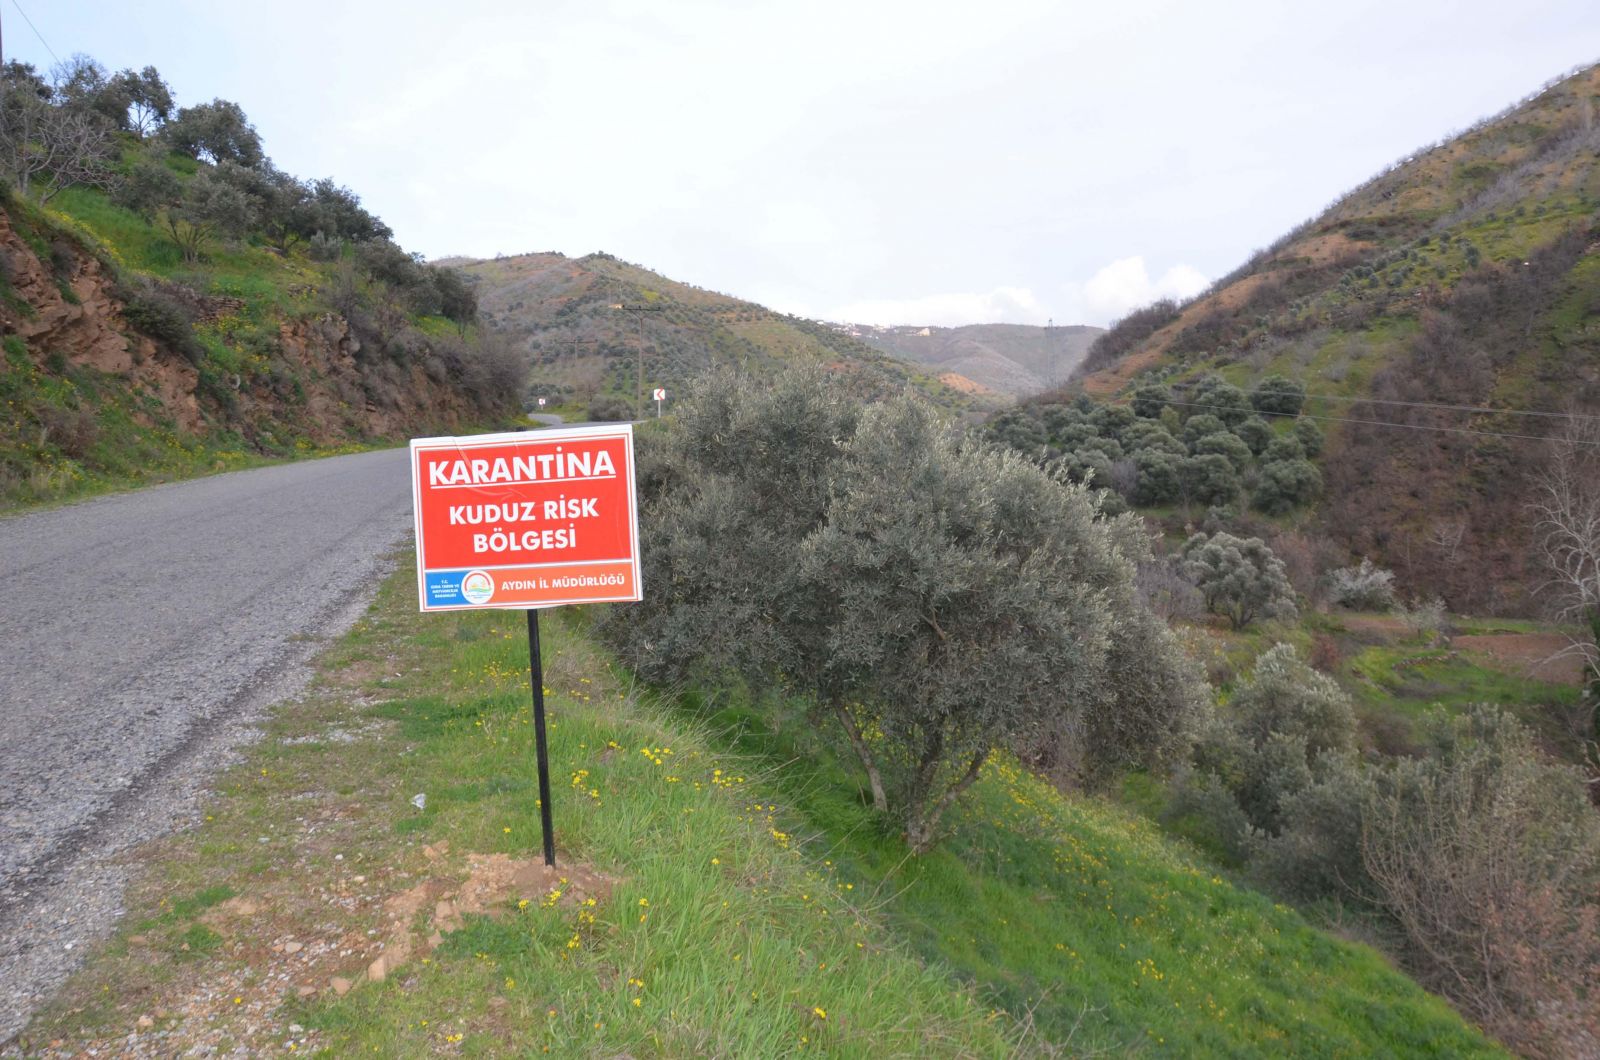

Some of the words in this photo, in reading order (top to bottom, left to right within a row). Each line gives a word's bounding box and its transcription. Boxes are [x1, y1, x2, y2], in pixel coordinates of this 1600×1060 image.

[428, 446, 616, 486] KARANTİNA
[449, 502, 536, 525] KUDUZ
[543, 494, 600, 520] RİSK
[473, 523, 577, 553] BÖLGESİ
[501, 580, 536, 591] AYDIN
[539, 577, 549, 590] İL
[551, 573, 625, 589] MÜDÜRLÜĞÜ
